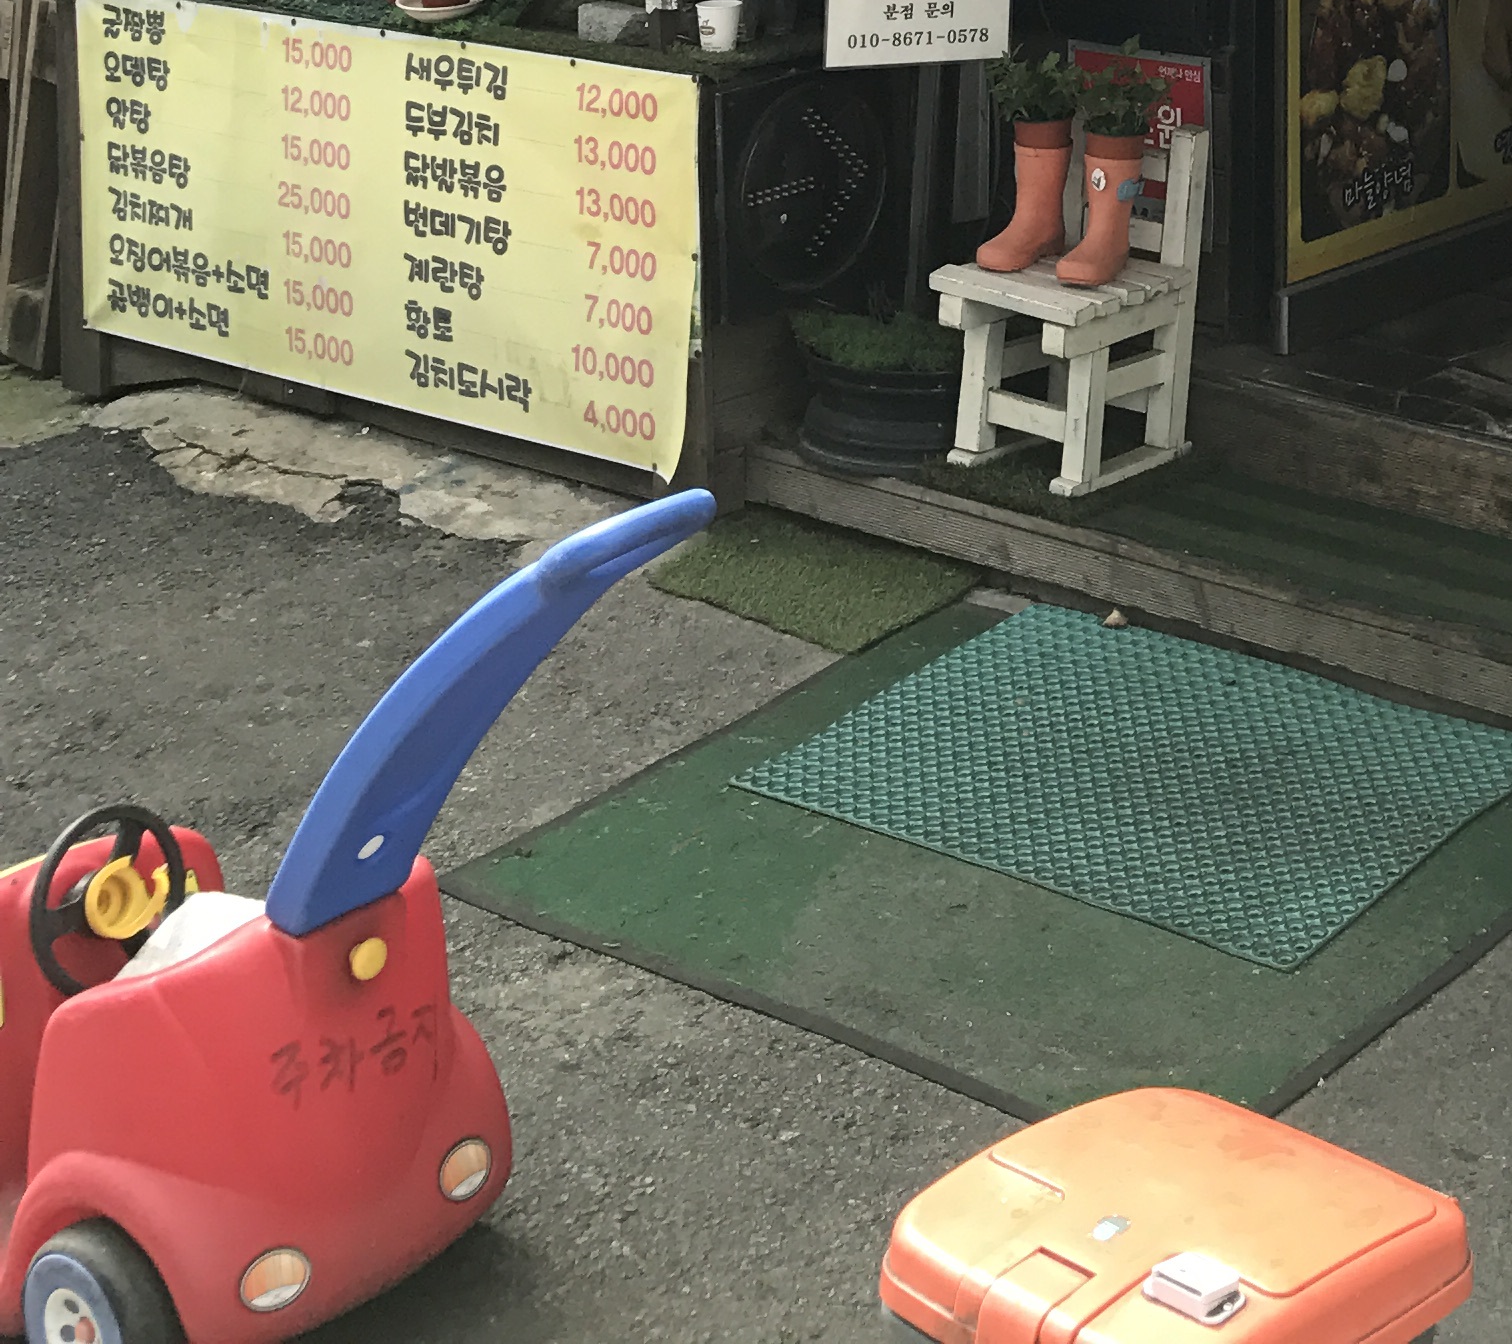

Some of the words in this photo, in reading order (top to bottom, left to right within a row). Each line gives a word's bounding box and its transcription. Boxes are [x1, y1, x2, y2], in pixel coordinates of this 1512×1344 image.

[102, 3, 166, 45] 굴짬뽕
[281, 36, 352, 72] 15,000
[847, 28, 990, 50] 010-8671-0578
[883, 2, 914, 20] 분점
[924, 1, 955, 19] 문의
[280, 85, 351, 122] 12,000
[405, 53, 508, 100] 새우튀김
[575, 83, 657, 123] 12,000
[105, 96, 151, 134] 알탕
[280, 135, 351, 172] 15,000
[405, 101, 500, 147] 두부김치
[573, 135, 657, 177] 13,000
[107, 141, 191, 189] 닭볶음탕
[277, 180, 351, 220] 25,000
[405, 152, 507, 203] 닭발볶음
[574, 187, 657, 229] 13,000
[1344, 160, 1415, 210] 마늘양념
[107, 186, 193, 231] 김치찌개
[281, 231, 352, 269] 15,000
[404, 201, 512, 254] 번데기탕
[585, 240, 657, 283] 7,000
[109, 232, 270, 300] 오징어볶음+소면
[282, 279, 354, 318] 15,000
[404, 253, 485, 300] 계란탕
[583, 294, 653, 336] 7,000
[106, 277, 231, 338] 골뱅이+소면
[284, 327, 354, 367] 15,000
[405, 349, 532, 413] 김치도시락
[582, 405, 656, 441] 4,000
[571, 345, 654, 389] 10,000
